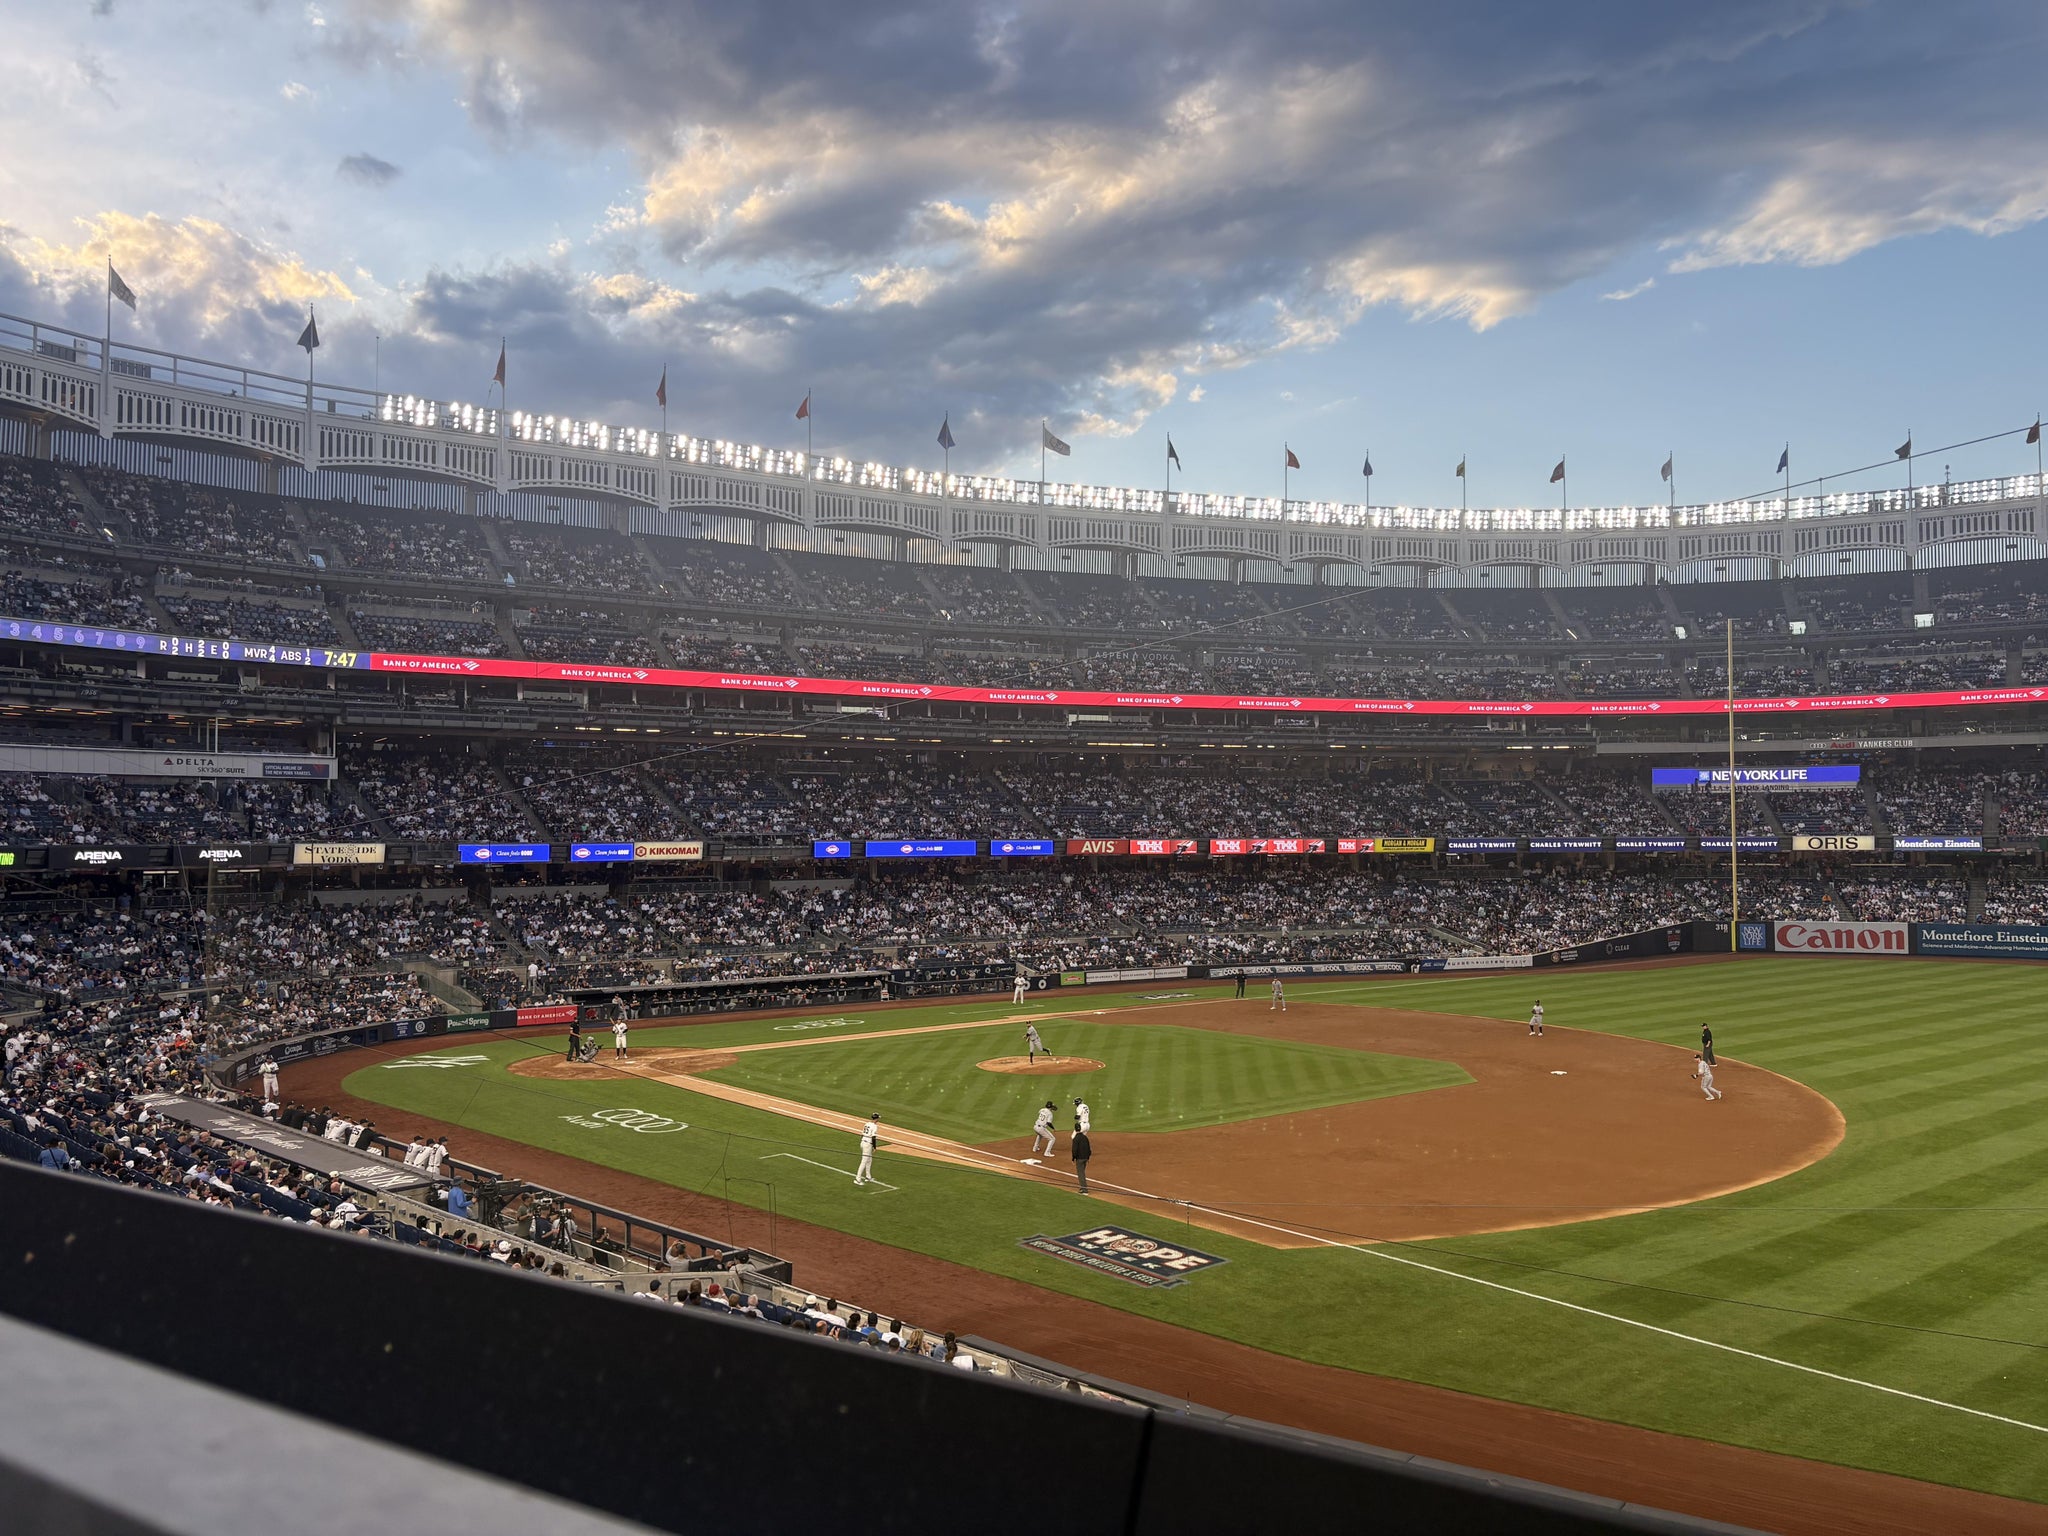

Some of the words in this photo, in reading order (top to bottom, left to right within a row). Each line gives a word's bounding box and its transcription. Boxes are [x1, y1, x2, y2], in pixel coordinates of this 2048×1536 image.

[10, 622, 20, 636] 3
[32, 625, 42, 639] 4
[54, 628, 63, 640] 5
[74, 630, 84, 643] 6
[96, 632, 104, 644] 7
[116, 634, 126, 648] 8
[136, 636, 146, 648] 9
[160, 640, 167, 650] R
[172, 638, 178, 646] 0
[185, 643, 192, 652] H
[198, 640, 204, 649] 2
[211, 646, 217, 654] E
[223, 642, 229, 650] 0
[245, 648, 268, 658] MVR
[269, 646, 275, 654] 4
[281, 651, 302, 661] ABS
[306, 649, 310, 657] 1
[324, 652, 356, 667] 7:47
[172, 647, 178, 656] 2
[198, 649, 204, 657] 2
[223, 651, 229, 659] 0
[305, 657, 311, 665] 2
[383, 659, 407, 667] BANK
[422, 662, 461, 670] AMERICA
[597, 671, 632, 679] AMERICA
[1830, 741, 1855, 749] Audi
[1858, 740, 1892, 748] YANKEES
[1894, 740, 1913, 748] CLUB
[176, 758, 214, 766] DELTA
[1712, 770, 1742, 780] NEW
[1744, 770, 1779, 780] YORK
[1781, 770, 1808, 780] LIFE
[1081, 841, 1115, 853] AVIS
[1137, 841, 1163, 851] THK
[1216, 840, 1241, 850] THK
[1808, 837, 1859, 850] ORIS
[1895, 840, 1943, 848] Montefiore
[1945, 840, 1980, 848] Einstein
[199, 850, 242, 858] ARENA
[305, 846, 376, 854] STATESIDE
[650, 847, 699, 855] KIKKOMAN
[75, 851, 122, 860] ARENA
[1777, 924, 1904, 950] Canon
[1922, 930, 1993, 942] Montefiore
[1997, 932, 2048, 943] Einstein
[469, 1017, 489, 1027] Spring
